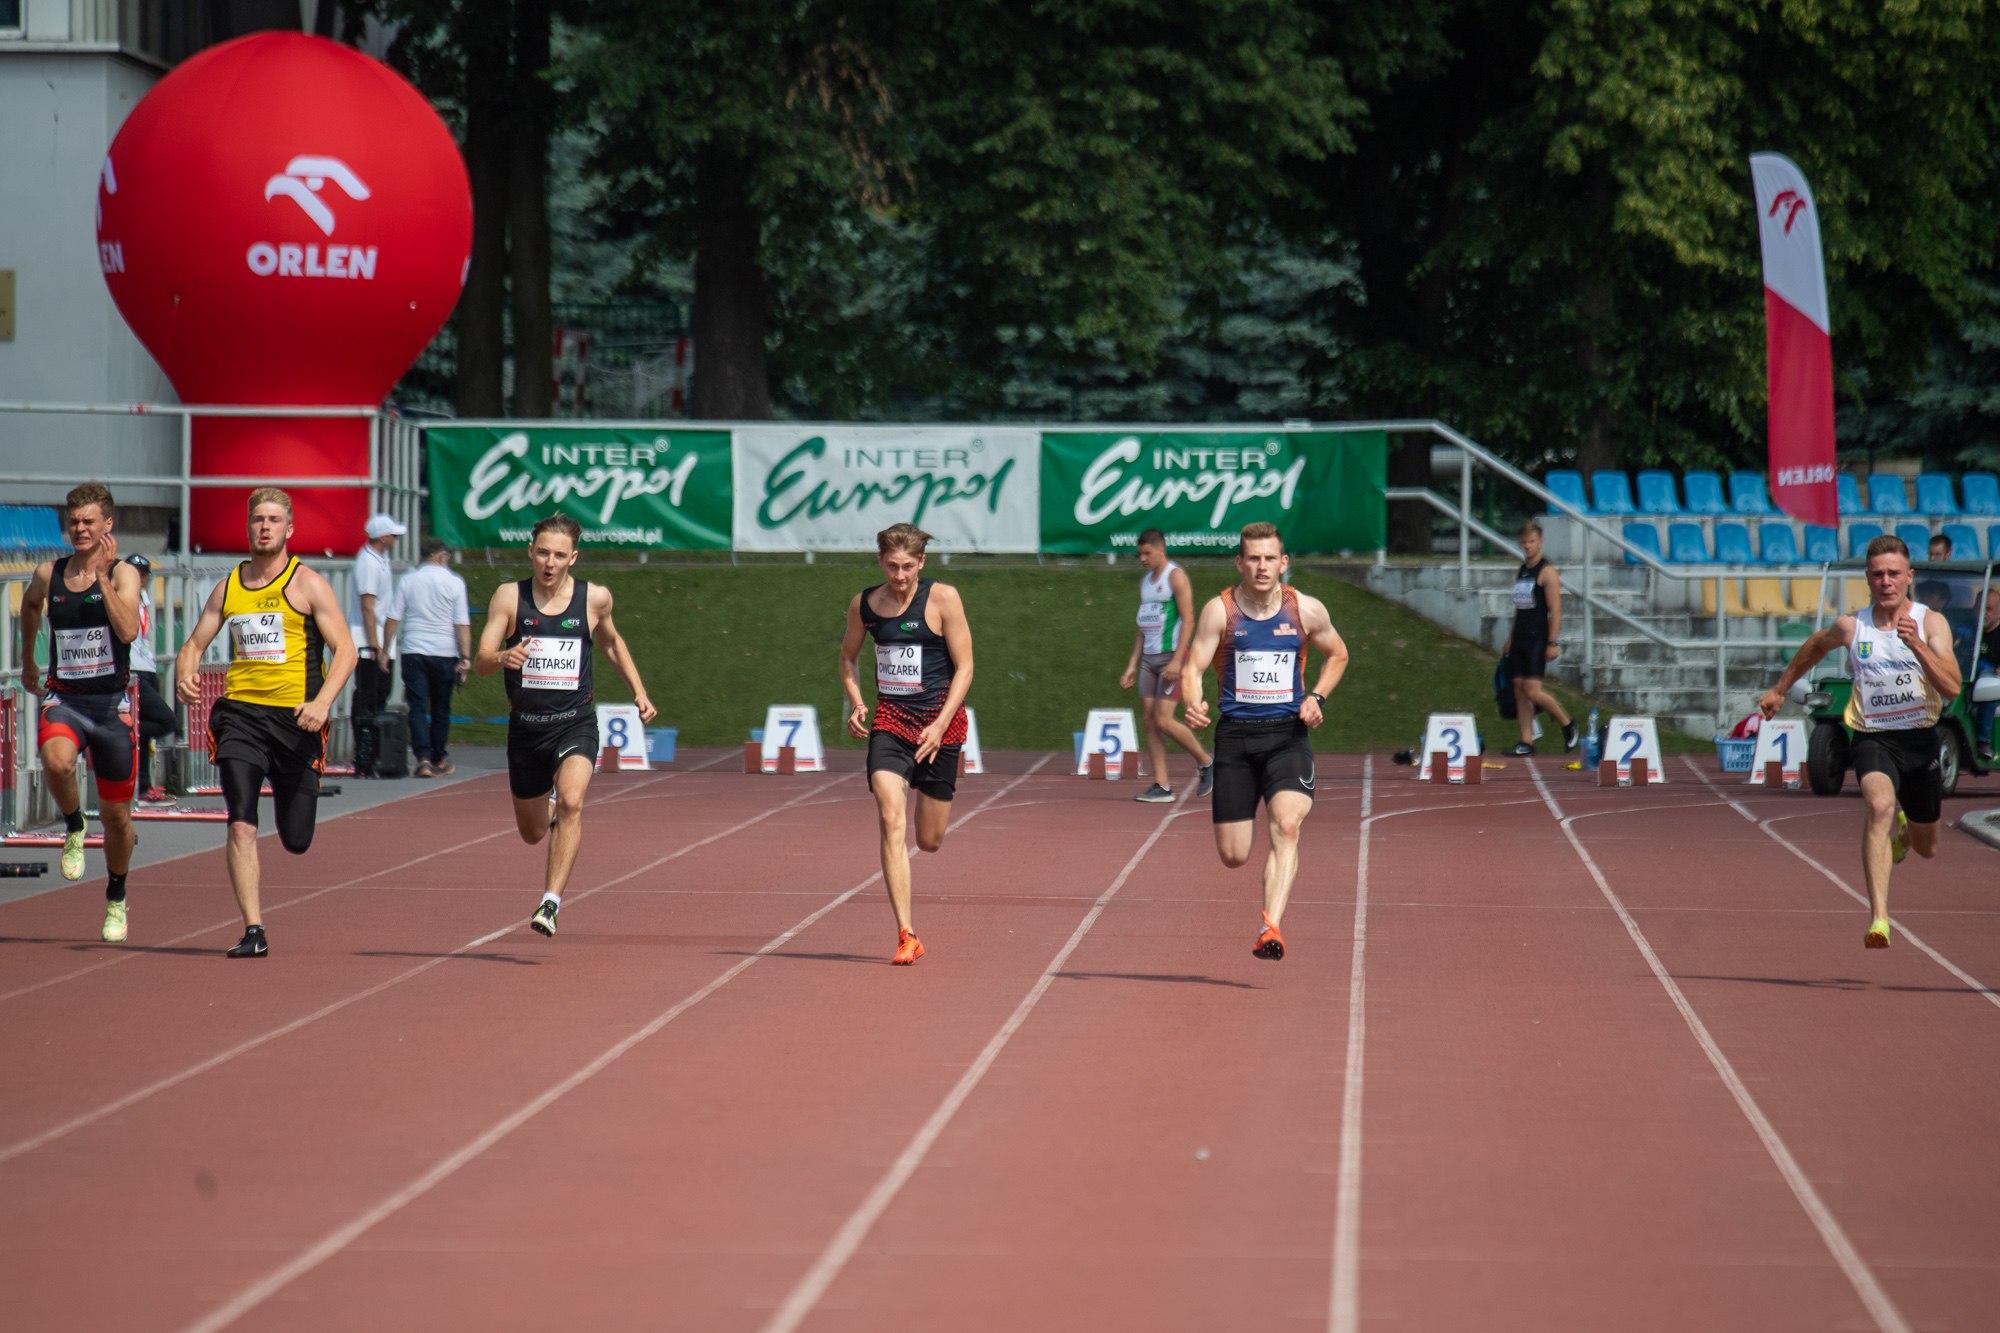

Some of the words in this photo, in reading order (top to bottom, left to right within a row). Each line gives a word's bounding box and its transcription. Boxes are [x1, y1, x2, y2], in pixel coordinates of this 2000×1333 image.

[247, 242, 378, 280] ORLEN
[542, 443, 658, 466] INTER
[844, 449, 969, 468] INTER
[1153, 446, 1266, 470] INTER
[462, 431, 698, 524] Europol
[756, 436, 1015, 530] Europol
[1073, 435, 1306, 529] Europol
[260, 615, 275, 626] 67
[86, 630, 103, 641] 68
[558, 641, 574, 652] 77
[899, 647, 914, 658] 70
[527, 657, 576, 671] ZIĘTARSKI
[1273, 654, 1288, 665] 74
[878, 663, 919, 676] OWCZAREK
[1252, 672, 1279, 683] SZAL
[1895, 673, 1912, 686] 63
[1870, 691, 1916, 707] GRZELAK
[520, 713, 550, 722] NIKE
[550, 710, 577, 721] PRO
[1872, 715, 1906, 724] WARSZAWA
[608, 717, 628, 751] 8
[778, 720, 802, 747] 7
[1098, 723, 1121, 758] 5
[1440, 728, 1462, 763] 3
[1619, 731, 1642, 765] 2
[1772, 733, 1787, 767] 1
